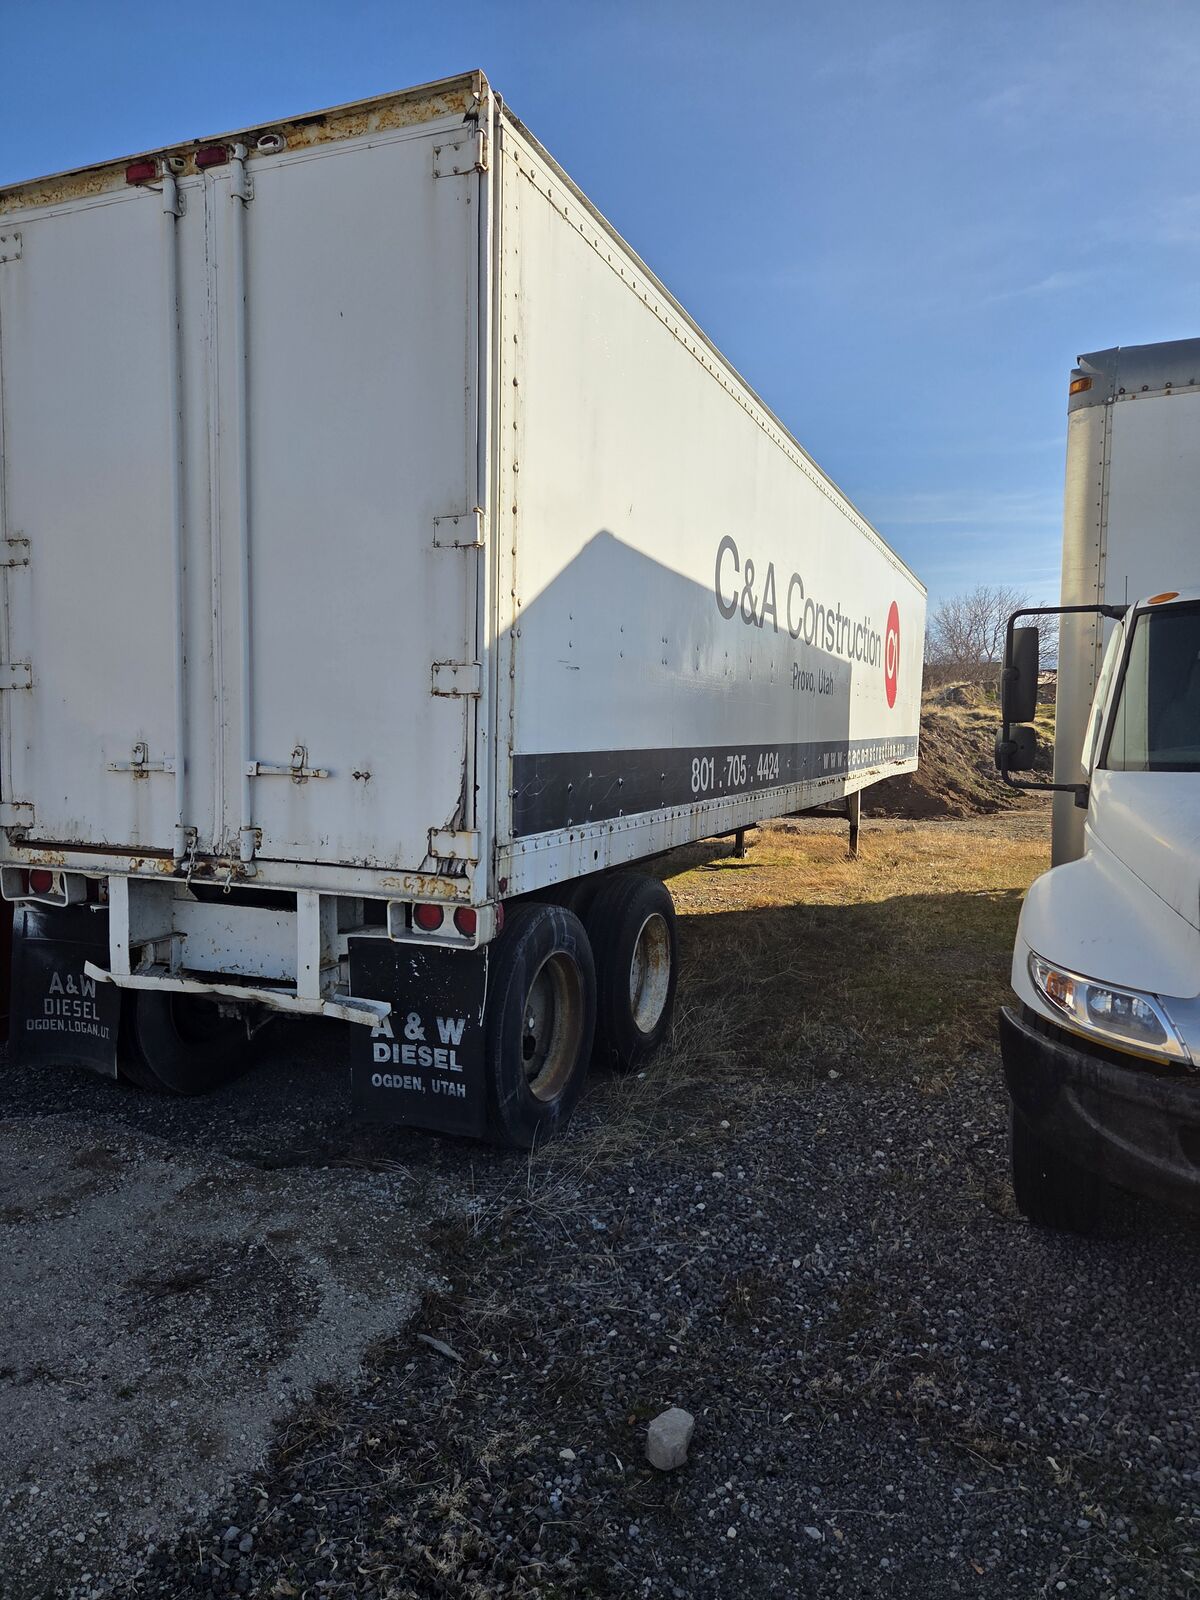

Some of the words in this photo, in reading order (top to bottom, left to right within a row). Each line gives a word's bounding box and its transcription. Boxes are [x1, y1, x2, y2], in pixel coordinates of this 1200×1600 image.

[715, 535, 778, 633] C&A
[787, 572, 881, 668] Construction
[793, 662, 815, 697] Provo,
[819, 668, 833, 695] Utah
[44, 998, 100, 1020] DIESEL
[370, 1014, 394, 1038] A
[404, 1012, 426, 1040] &
[436, 1016, 466, 1045] W
[373, 1042, 463, 1072] DIESEL
[371, 1073, 426, 1094] OGDEN,
[432, 1079, 466, 1098] UTAH
